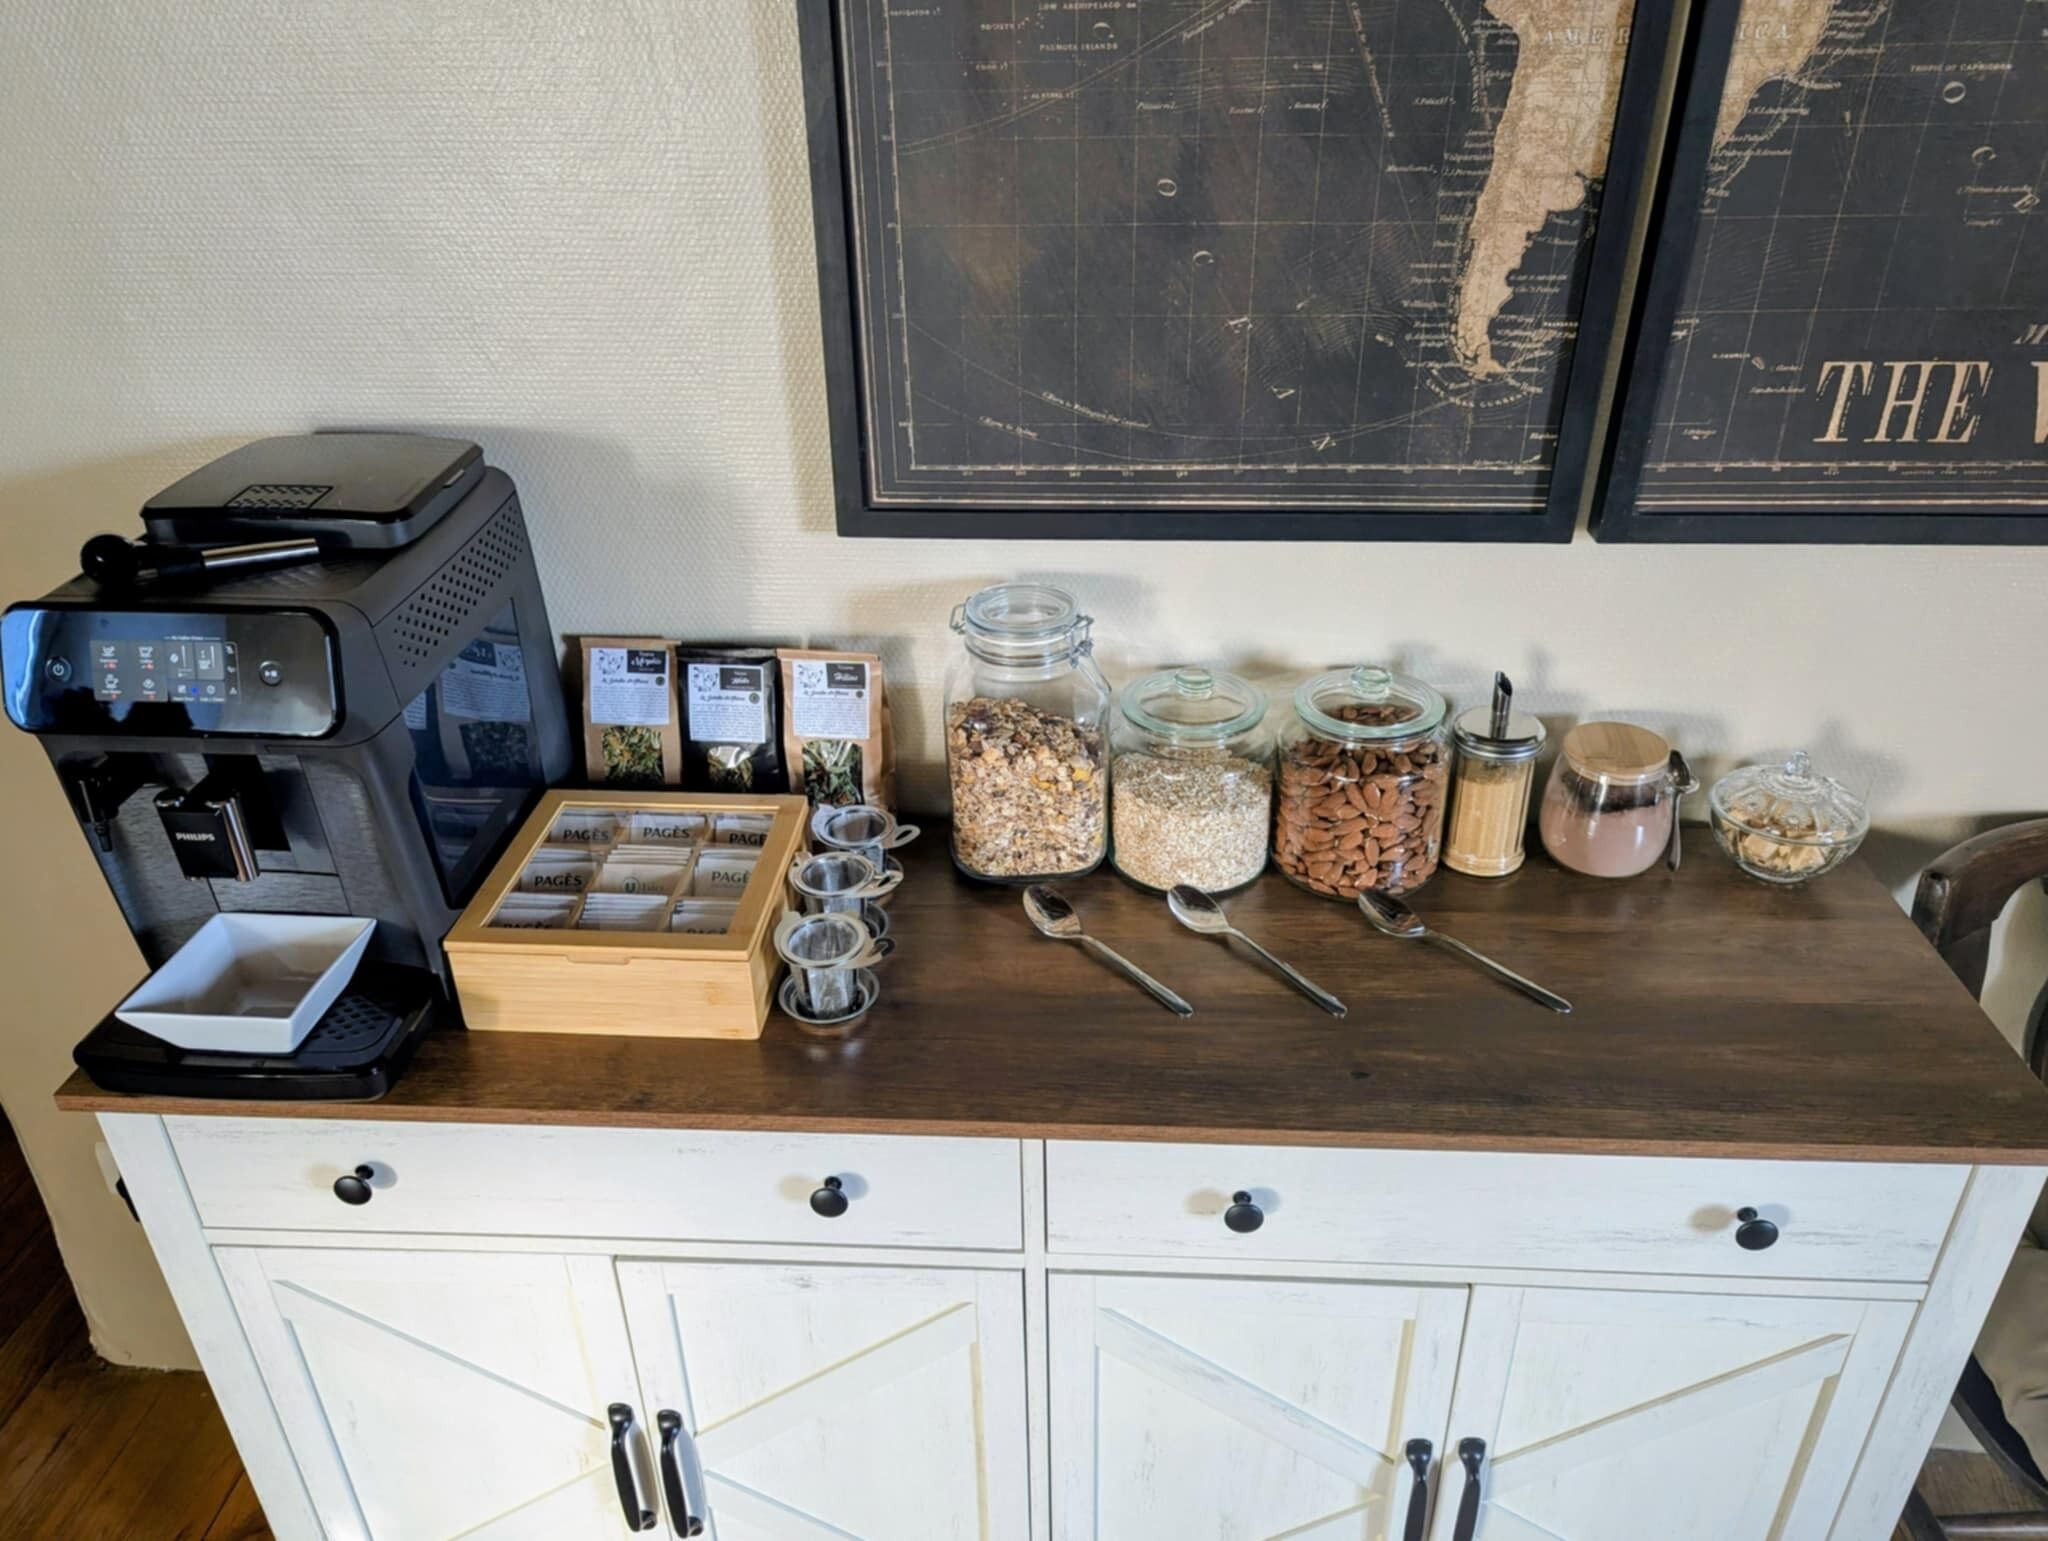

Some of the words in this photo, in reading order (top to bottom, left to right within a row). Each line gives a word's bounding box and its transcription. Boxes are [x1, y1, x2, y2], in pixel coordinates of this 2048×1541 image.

[1812, 360, 1994, 444] THE
[175, 832, 216, 842] PHILIPS
[563, 827, 610, 842] PAGÈS
[643, 825, 691, 839] PAGÈS
[533, 873, 583, 888] PAGÈS
